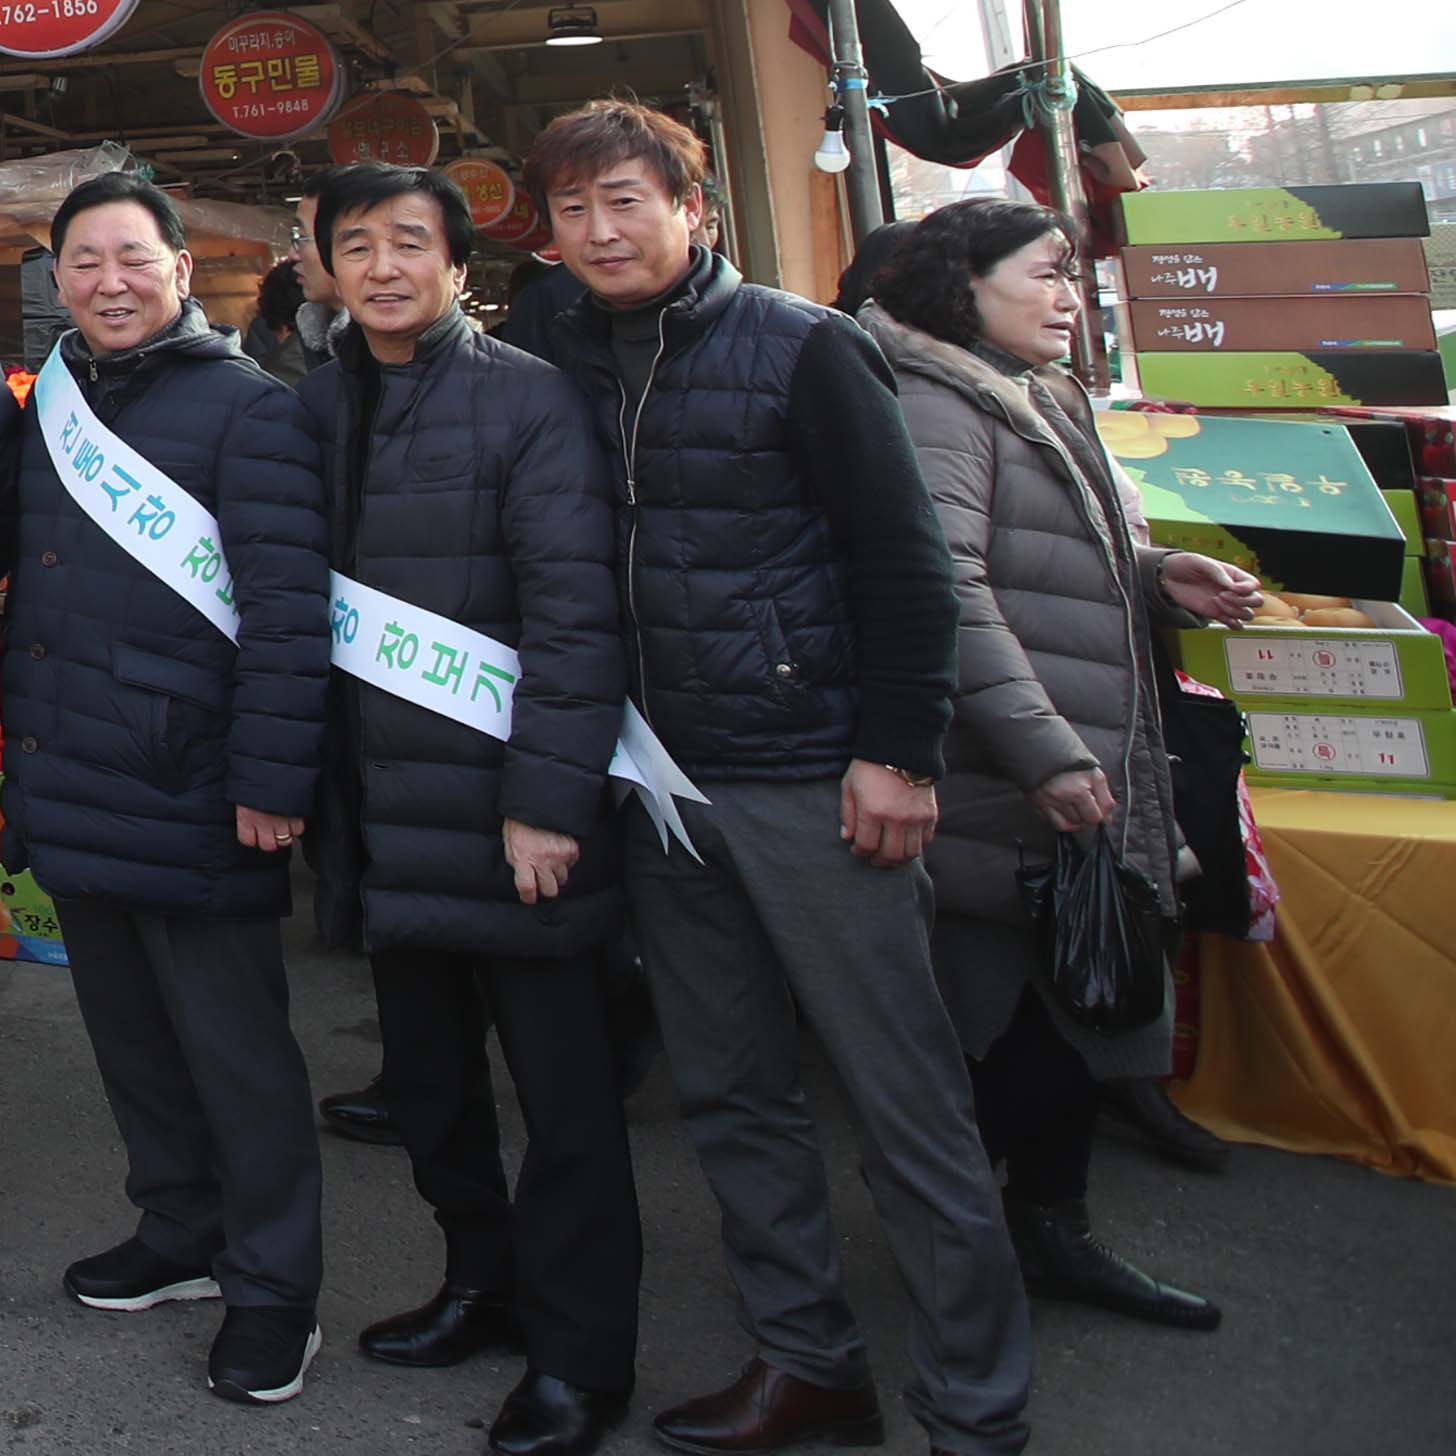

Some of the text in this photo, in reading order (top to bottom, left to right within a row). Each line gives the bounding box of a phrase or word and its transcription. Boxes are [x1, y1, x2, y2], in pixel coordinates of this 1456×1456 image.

[213, 54, 321, 99] 동구민물
[59, 411, 176, 540] 전통시장
[376, 620, 515, 713] 장보기
[25, 914, 58, 933] 장수
